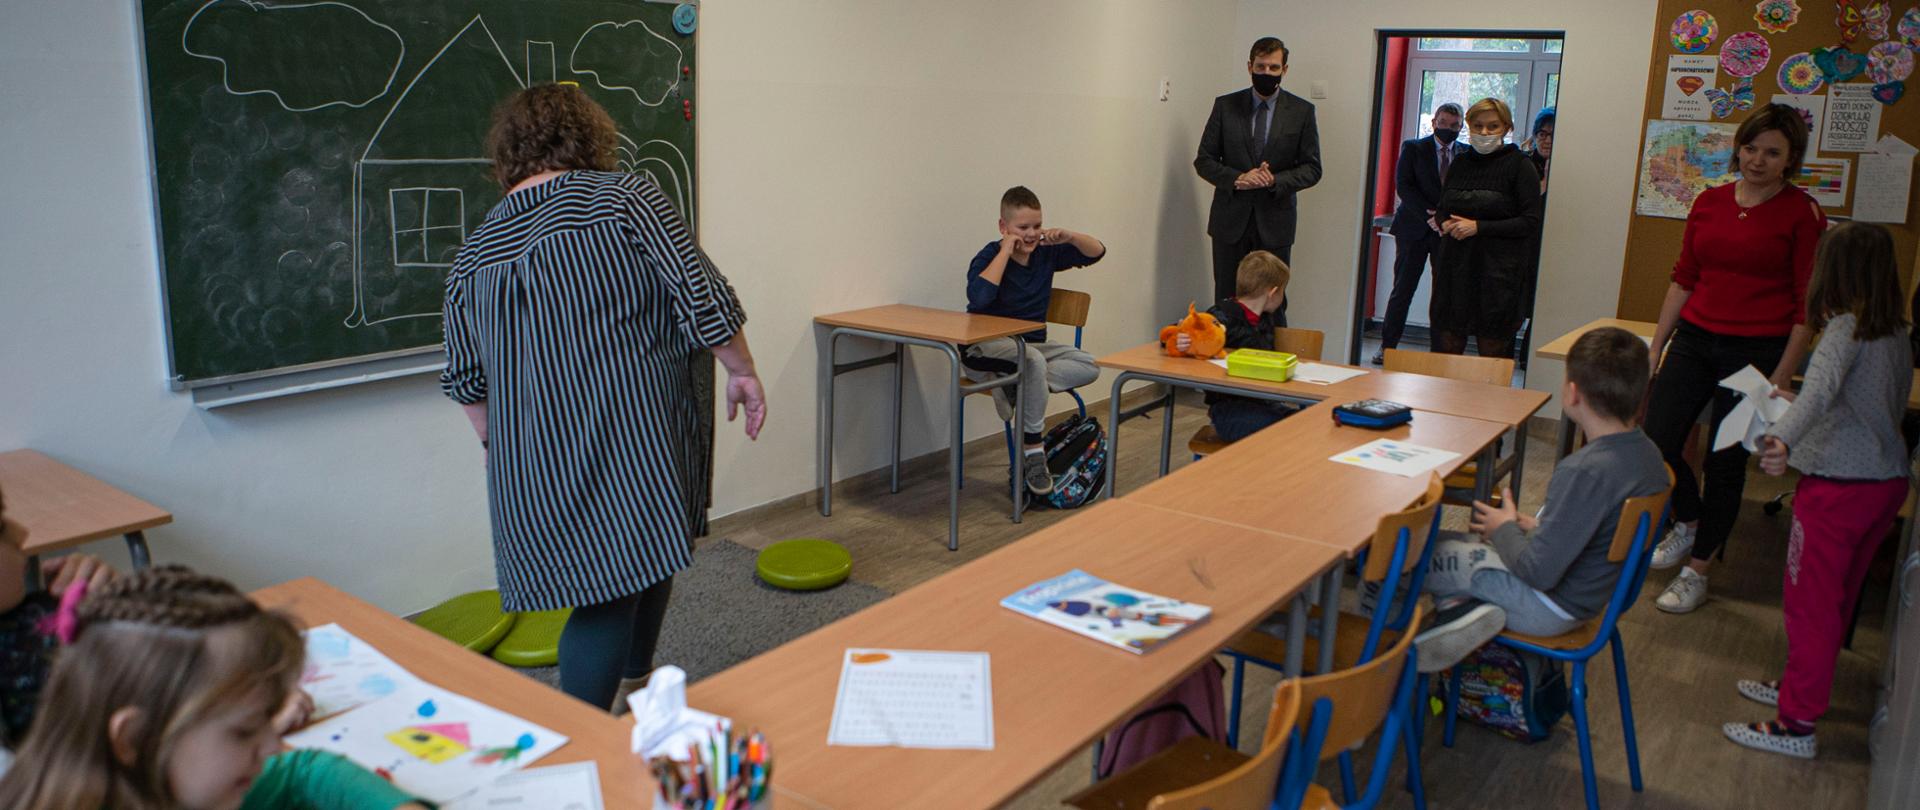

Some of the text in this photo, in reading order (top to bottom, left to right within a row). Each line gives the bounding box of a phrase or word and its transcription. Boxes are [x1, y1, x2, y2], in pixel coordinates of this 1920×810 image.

[1852, 103, 1874, 111] DOBRY
[1831, 112, 1871, 122] DZIĘKUJĘ
[1830, 121, 1868, 133] PROSZĘ
